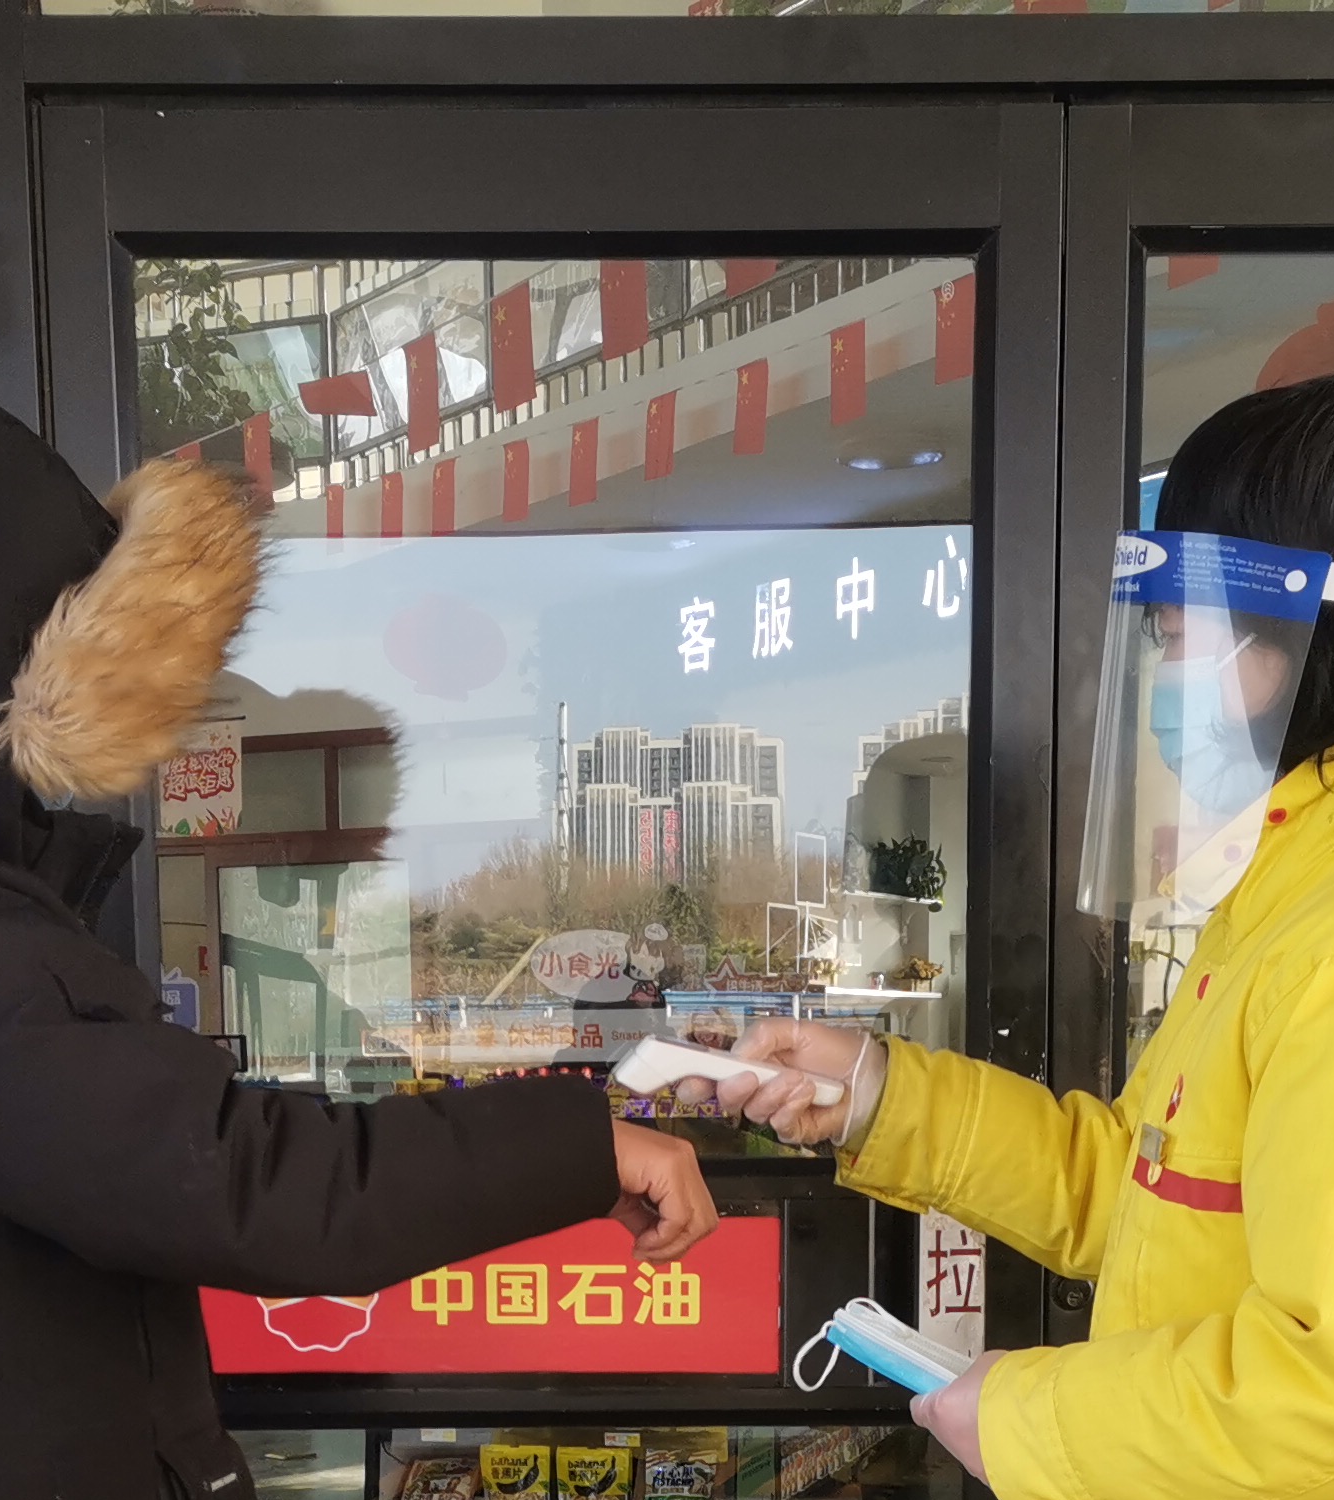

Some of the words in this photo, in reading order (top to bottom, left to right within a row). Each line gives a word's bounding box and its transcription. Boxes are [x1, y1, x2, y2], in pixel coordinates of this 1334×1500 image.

[676, 534, 968, 675] 客服中心
[538, 951, 621, 980] 小食光
[508, 1023, 603, 1048] 休闲食品
[411, 1261, 702, 1326] 中国石油
[928, 1229, 983, 1319] 拉
